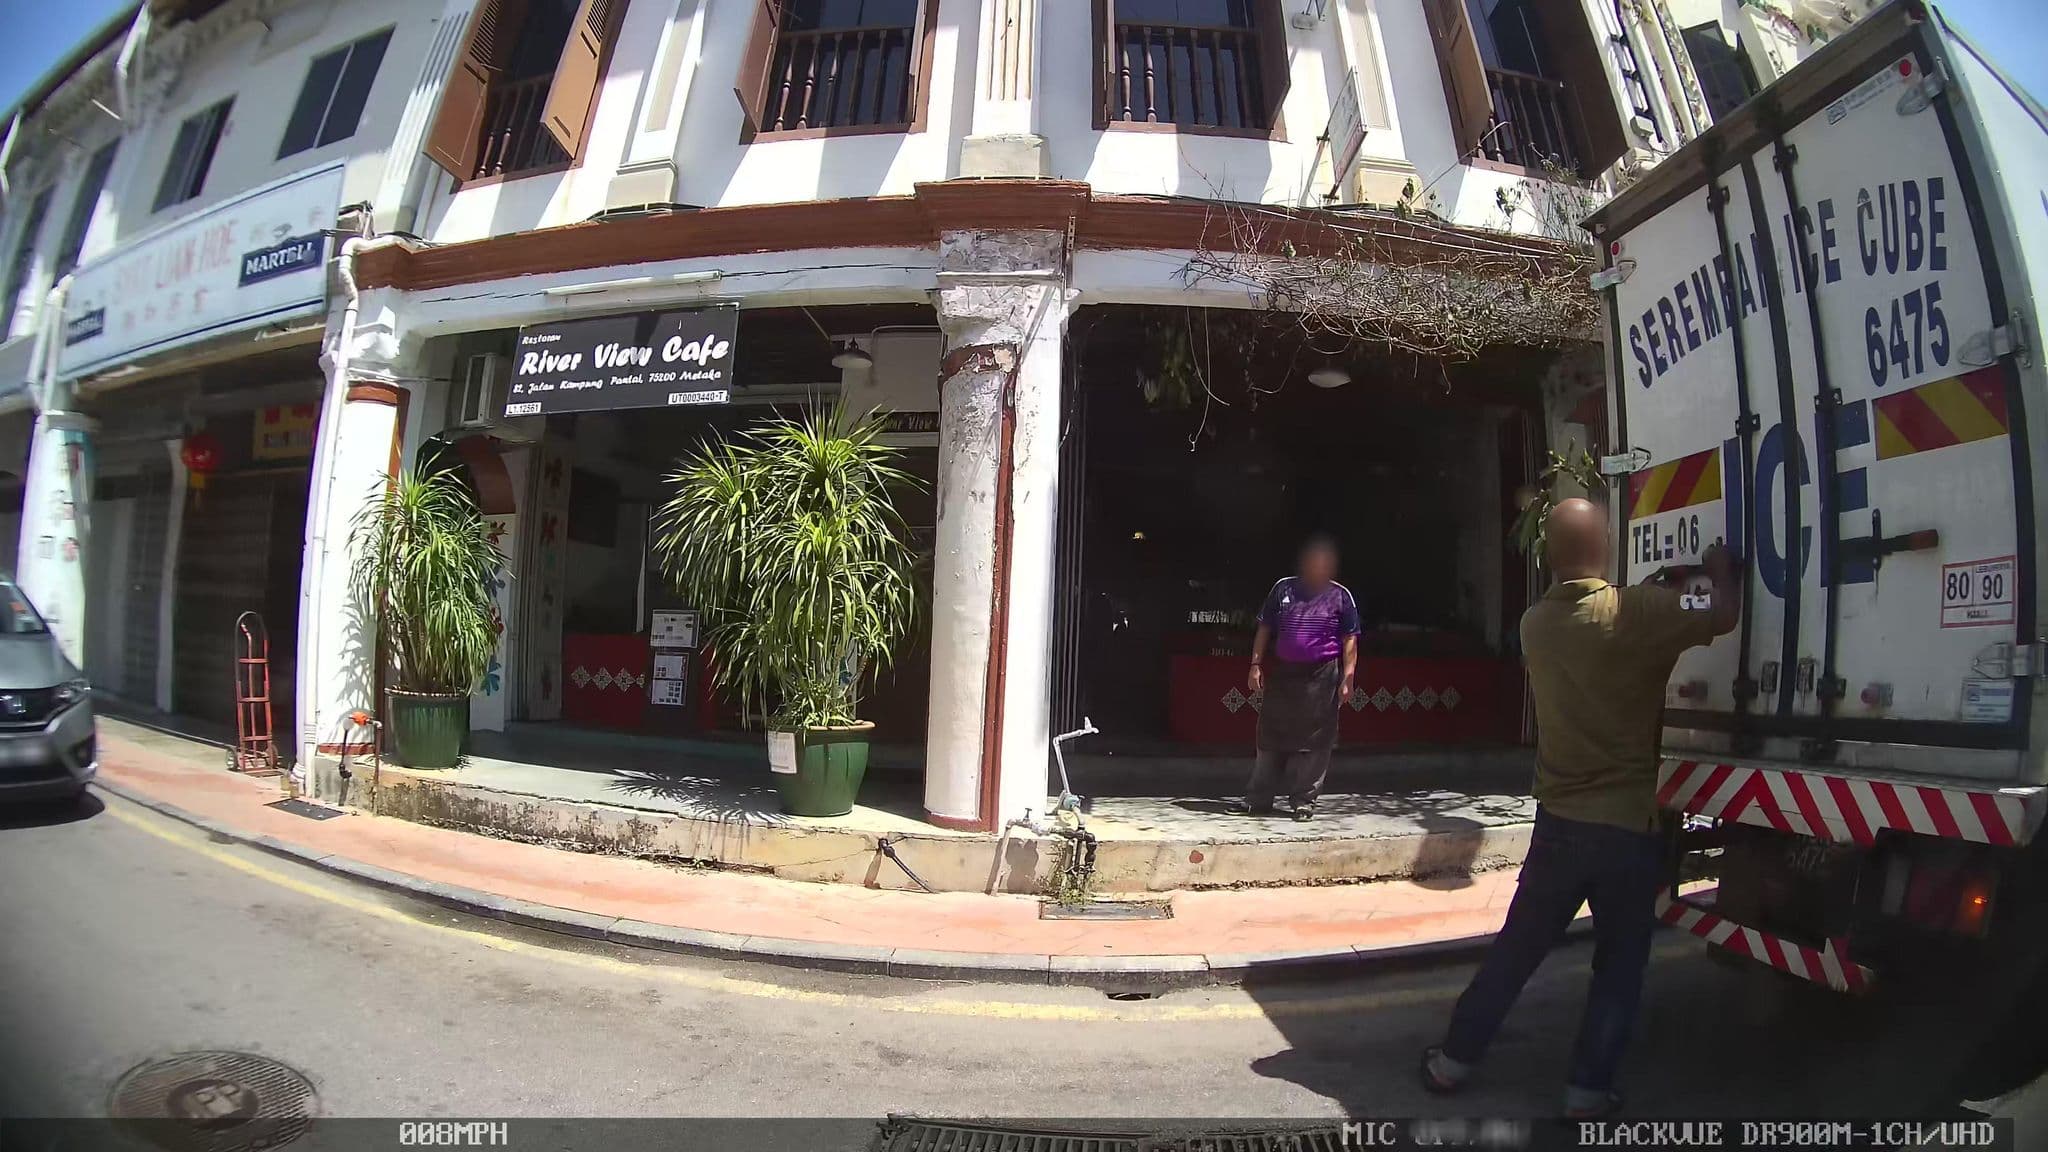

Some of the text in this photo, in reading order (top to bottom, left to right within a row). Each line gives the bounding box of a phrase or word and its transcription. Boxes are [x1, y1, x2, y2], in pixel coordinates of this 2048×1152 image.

[1783, 198, 1843, 294] ICE
[1857, 176, 1948, 277] CUBE
[519, 334, 730, 376] River View Cafe
[1865, 281, 1951, 388] 6475
[527, 381, 554, 395] Jalan
[559, 379, 604, 390] Kampung
[648, 372, 677, 383] 75200
[679, 369, 722, 381] Melaka
[1723, 398, 1875, 600] ICE
[1946, 572, 2003, 600] 80 90
